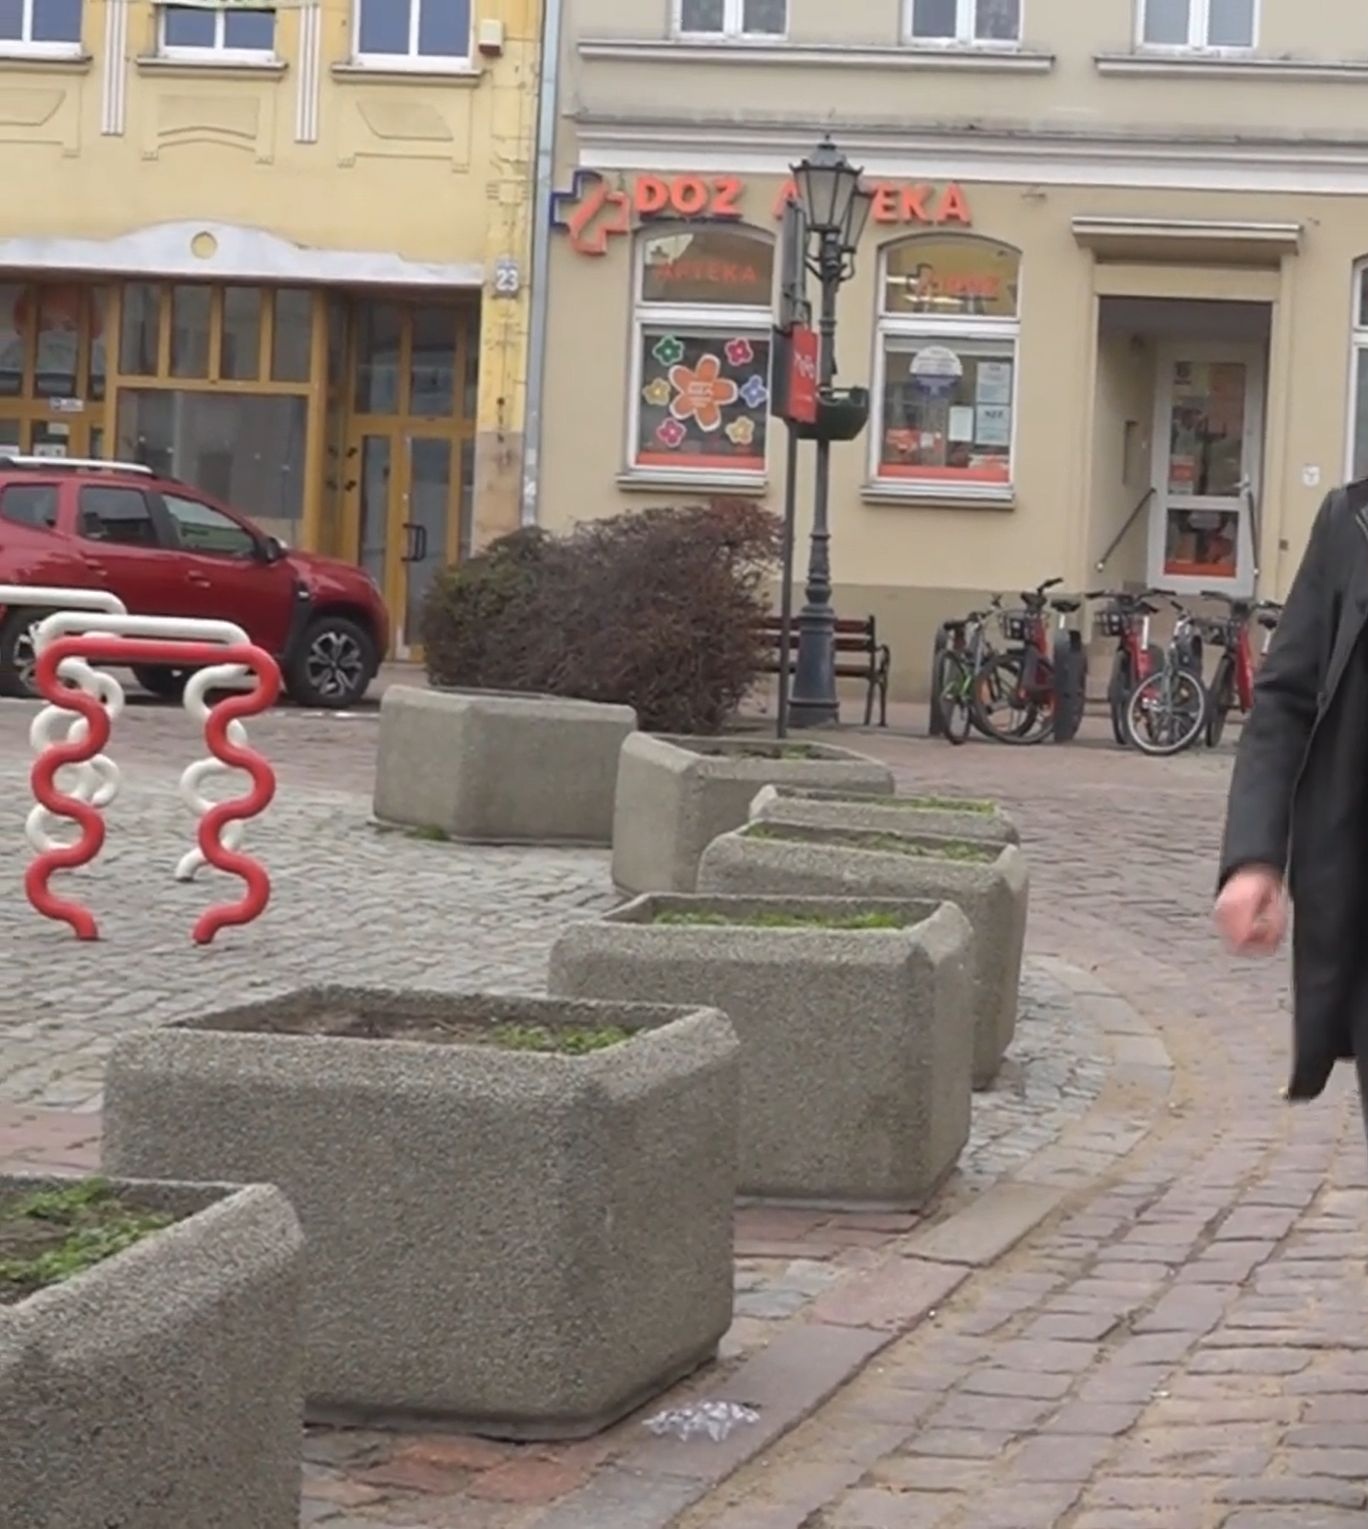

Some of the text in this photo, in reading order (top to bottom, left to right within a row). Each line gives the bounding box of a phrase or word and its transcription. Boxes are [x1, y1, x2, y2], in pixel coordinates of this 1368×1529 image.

[634, 174, 971, 227] DOZ AEKA
[496, 269, 518, 291] 23
